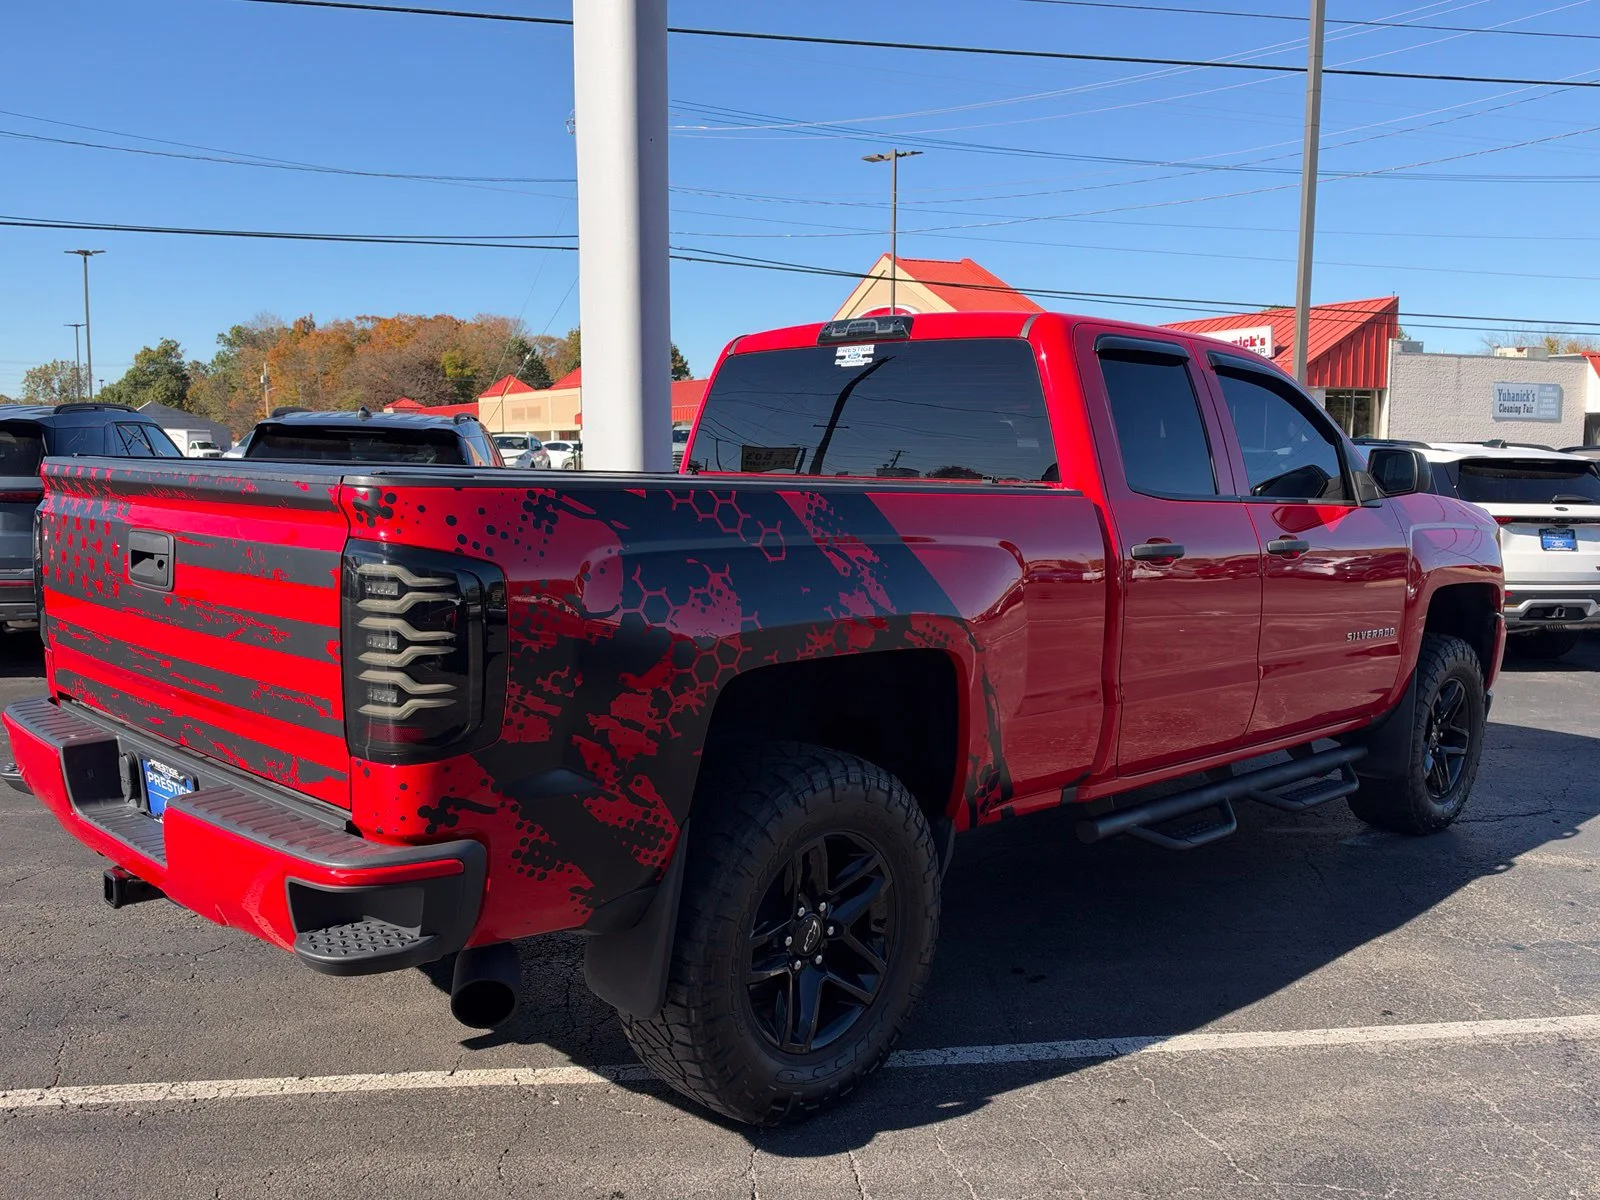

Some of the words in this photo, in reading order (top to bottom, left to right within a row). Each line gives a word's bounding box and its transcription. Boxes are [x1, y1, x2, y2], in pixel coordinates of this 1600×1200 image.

[837, 345, 873, 353] PRESTIGE
[1497, 388, 1536, 402] Yuhanick's
[1498, 403, 1522, 415] Cleaning
[1522, 403, 1534, 414] Fair
[1346, 627, 1395, 642] SILVERADO
[147, 771, 192, 796] PRESTIG
